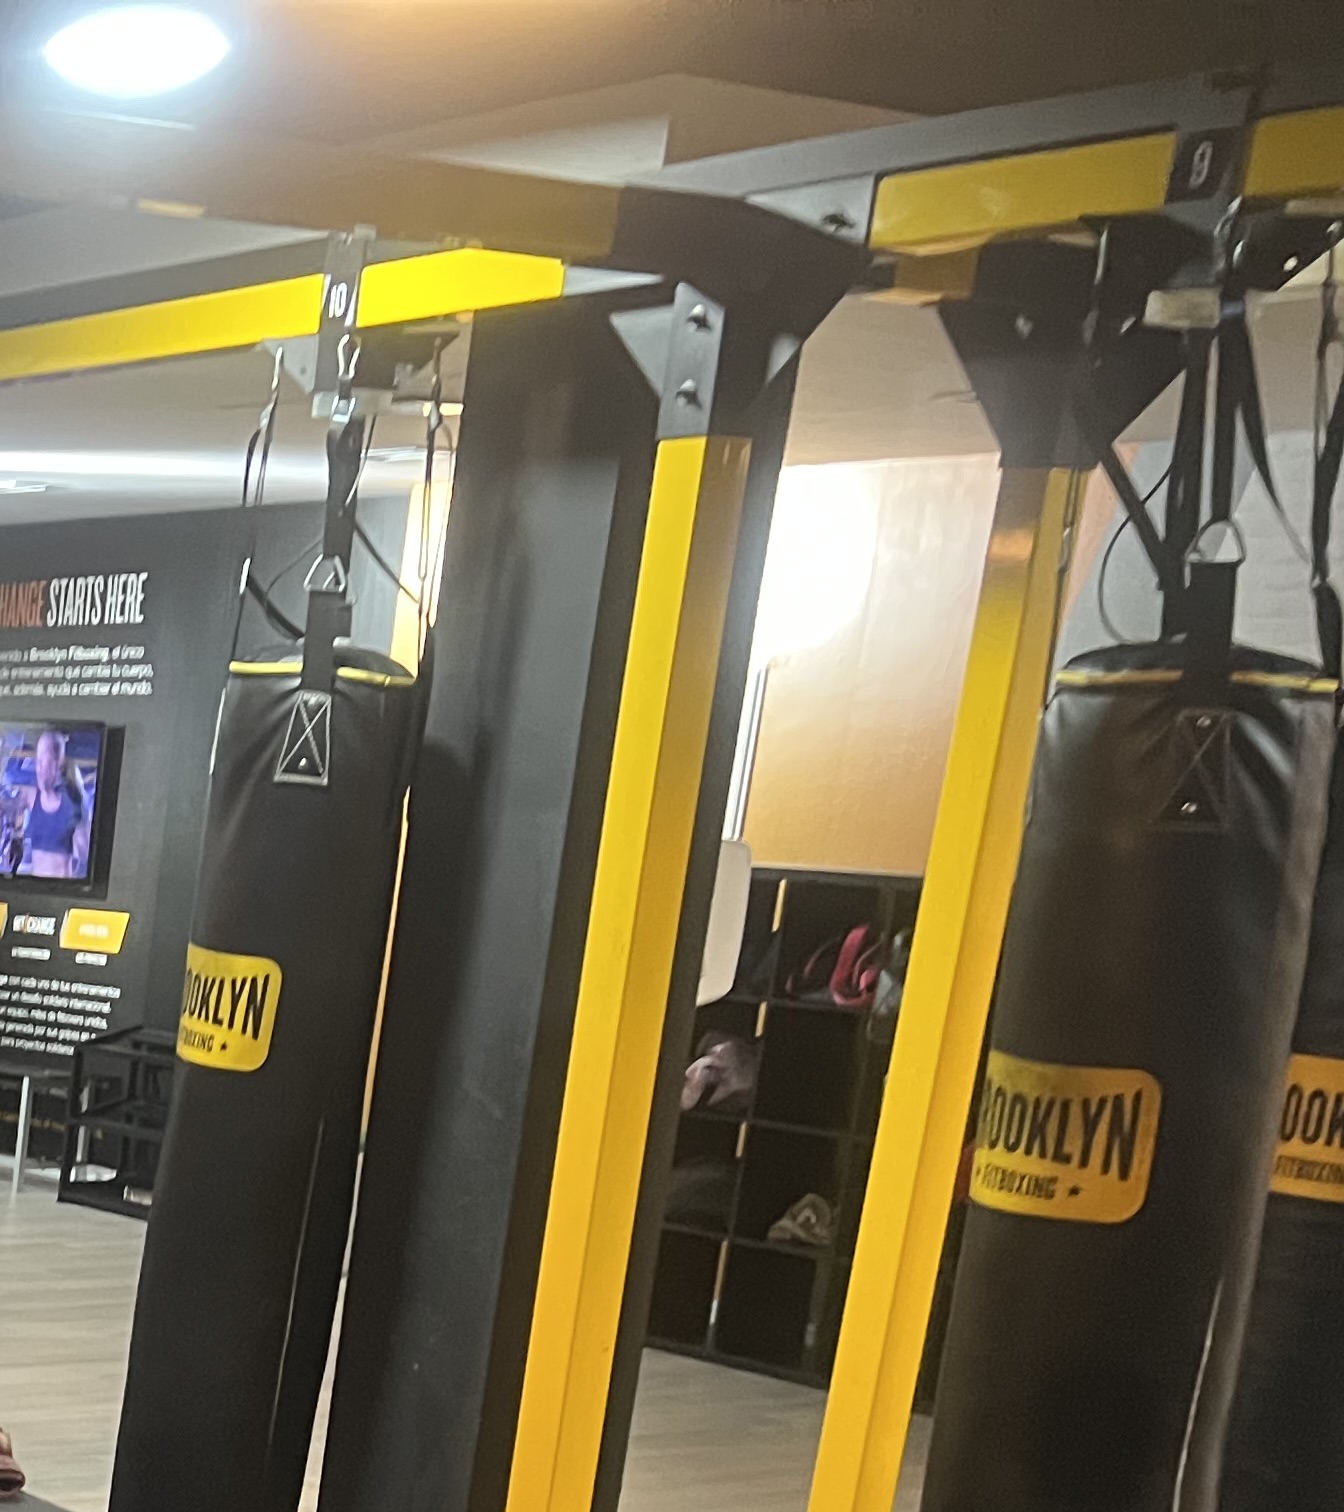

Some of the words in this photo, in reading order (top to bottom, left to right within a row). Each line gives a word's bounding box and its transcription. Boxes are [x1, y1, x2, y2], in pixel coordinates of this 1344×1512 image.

[328, 282, 348, 318] 10
[47, 574, 105, 627] STARTS
[104, 571, 148, 625] HERE
